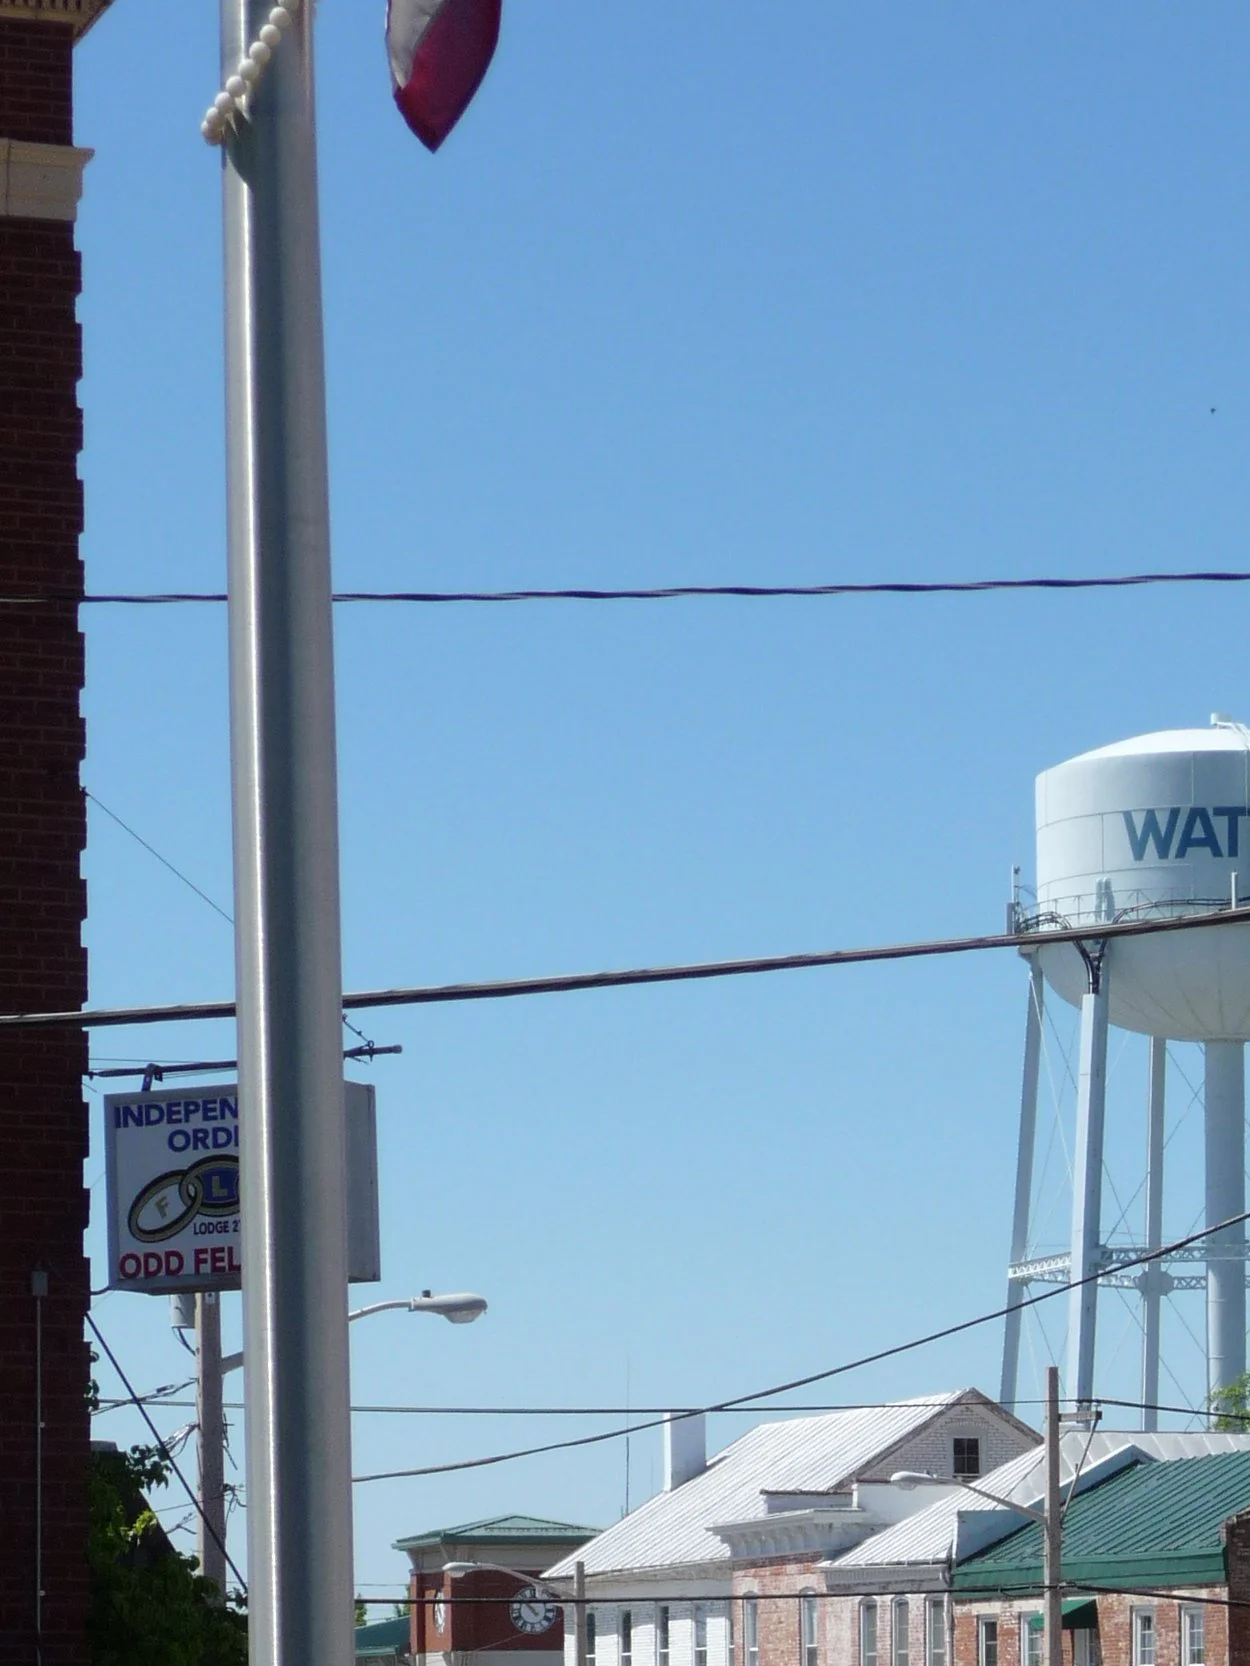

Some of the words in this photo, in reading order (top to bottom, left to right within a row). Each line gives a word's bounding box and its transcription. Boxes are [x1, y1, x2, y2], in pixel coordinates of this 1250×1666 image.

[115, 1097, 239, 1129] INDEPEN
[193, 1221, 230, 1236] LODGE
[119, 1251, 185, 1281] ODD
[194, 1246, 242, 1275] FEL
